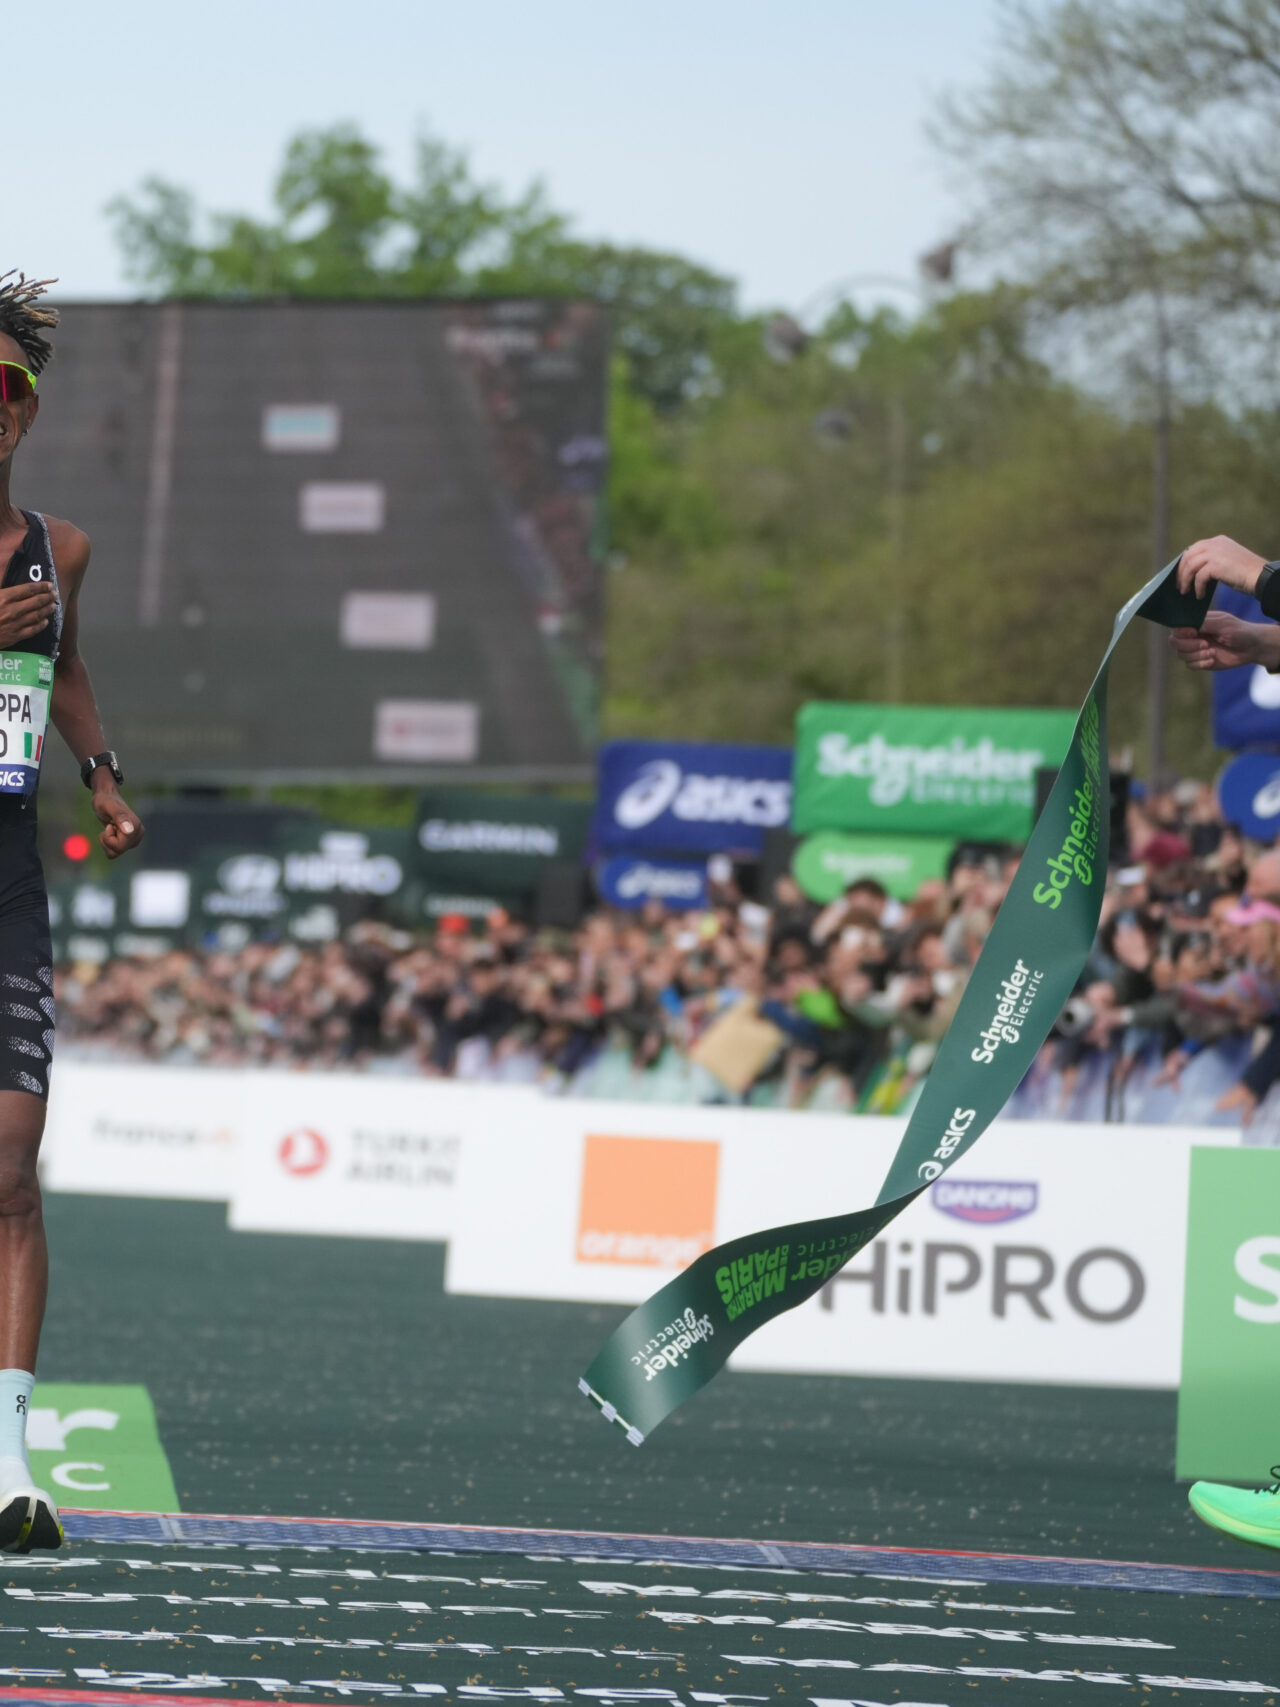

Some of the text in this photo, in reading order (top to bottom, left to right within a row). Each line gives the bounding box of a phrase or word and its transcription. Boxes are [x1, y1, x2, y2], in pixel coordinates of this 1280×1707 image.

[817, 732, 1045, 780] Schneider
[673, 773, 793, 828] asics
[1033, 771, 1095, 910] Schneider
[971, 958, 1030, 1064] Schneider
[1013, 969, 1045, 1027] Electric
[933, 1106, 977, 1160] asics
[581, 1230, 700, 1268] orange
[715, 1249, 782, 1305] PARIS
[820, 1237, 1148, 1324] HiPRO
[630, 1317, 687, 1366] Electric
[643, 1313, 714, 1382] Schneider
